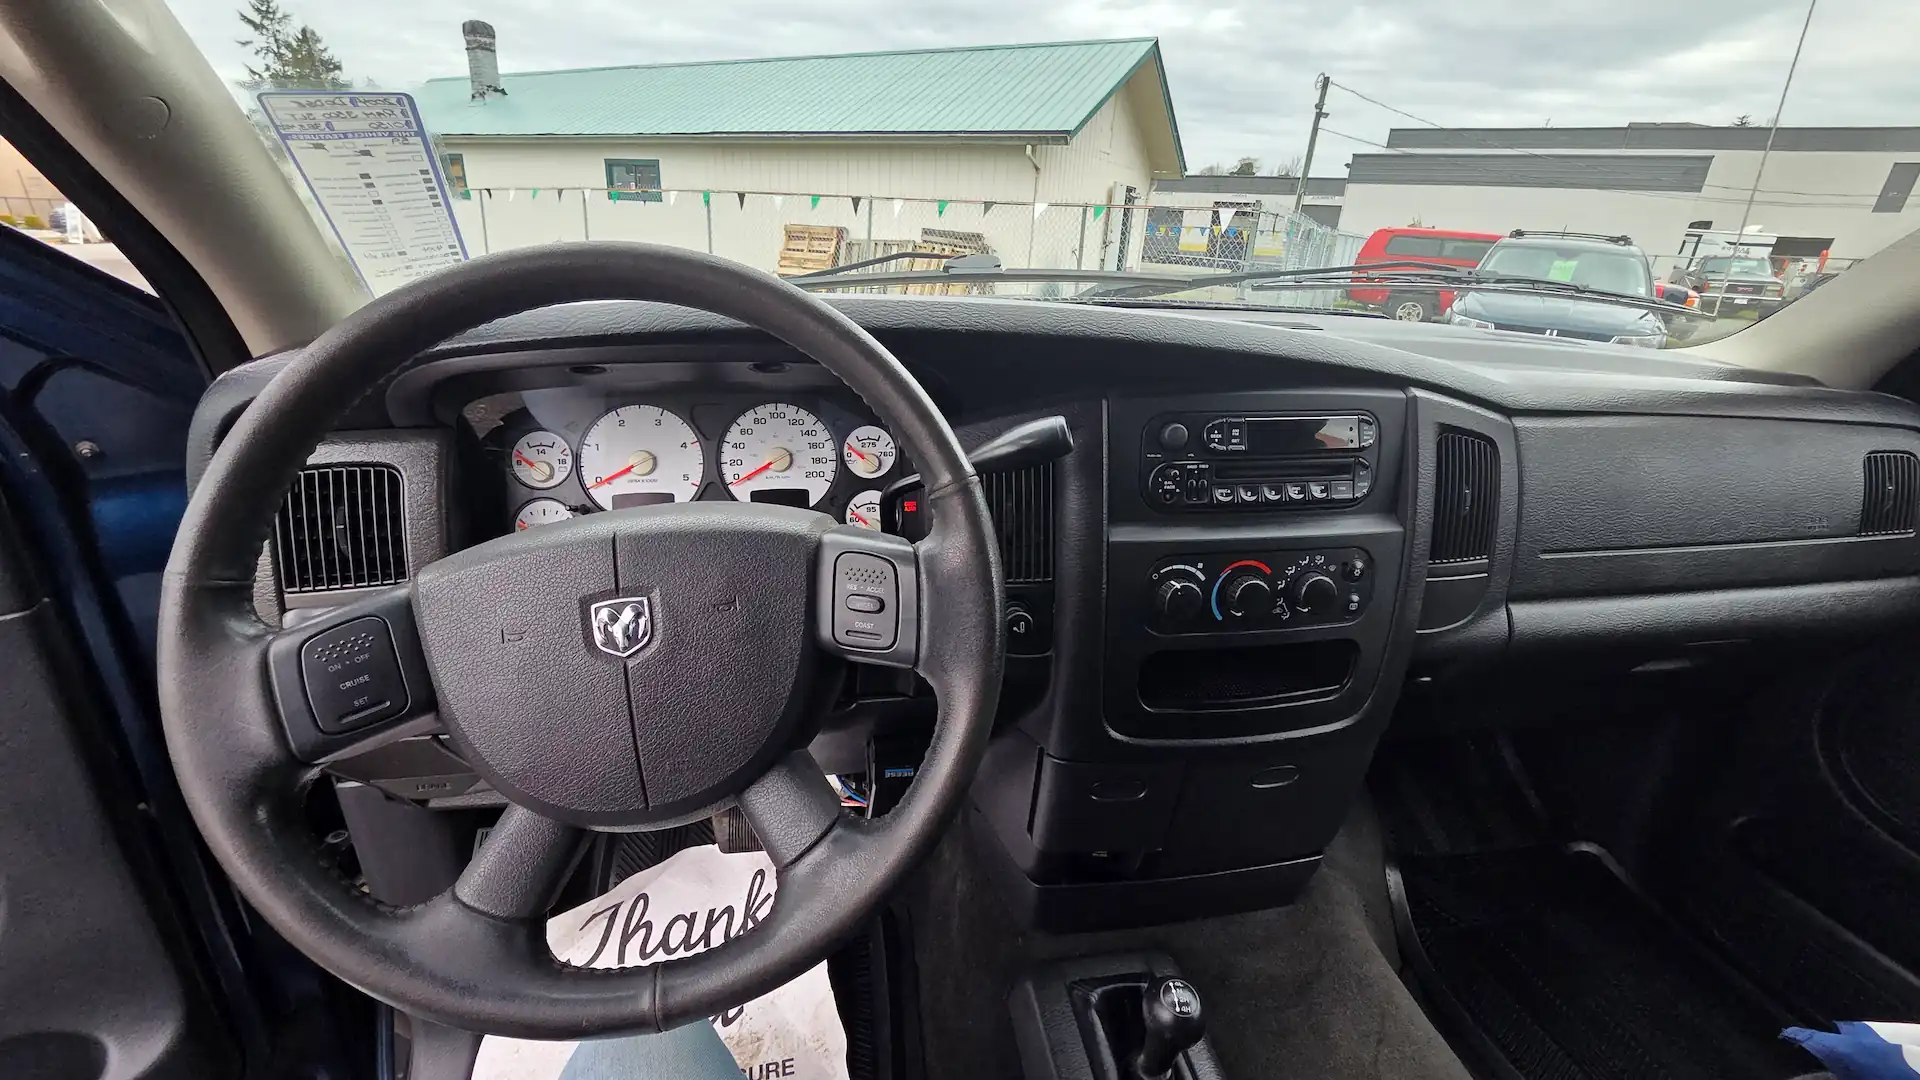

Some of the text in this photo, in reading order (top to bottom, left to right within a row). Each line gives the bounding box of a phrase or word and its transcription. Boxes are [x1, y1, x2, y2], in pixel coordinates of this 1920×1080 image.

[680, 442, 688, 450] 4
[328, 653, 371, 673] ON OFF
[340, 674, 371, 690] CRUISE
[353, 696, 368, 707] SET
[566, 868, 773, 968] Thank
